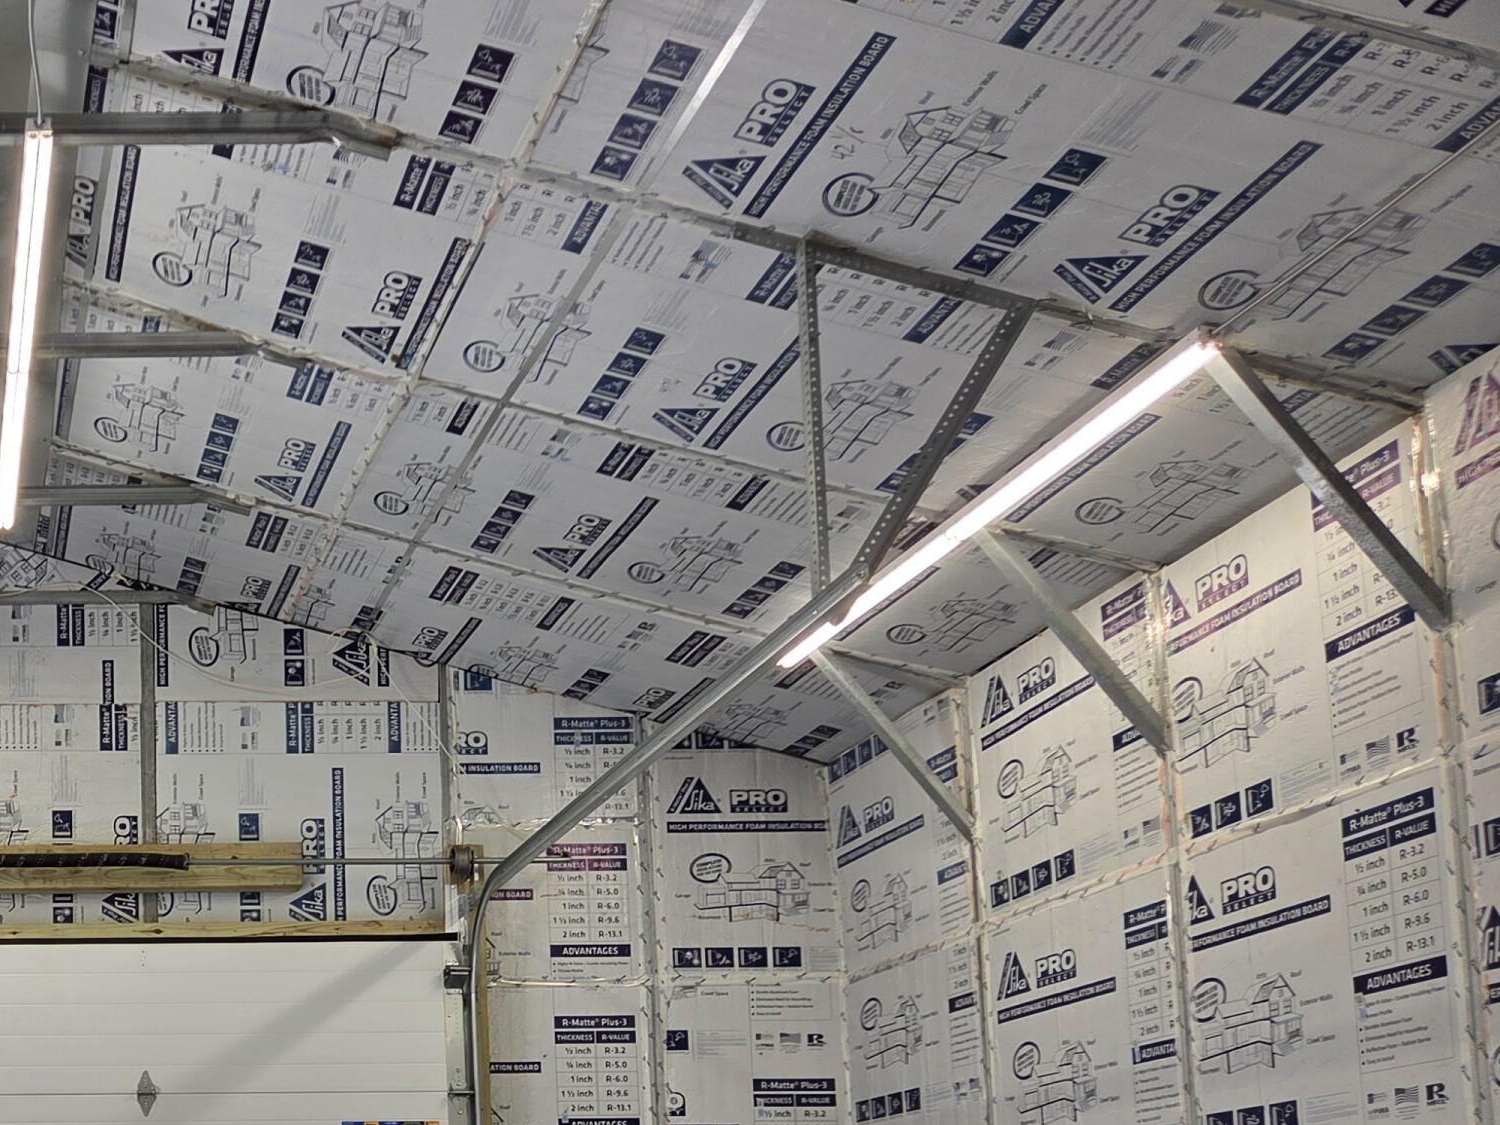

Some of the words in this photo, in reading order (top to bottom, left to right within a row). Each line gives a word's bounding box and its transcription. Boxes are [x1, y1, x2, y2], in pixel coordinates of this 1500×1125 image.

[860, 36, 889, 72] BOARD
[734, 79, 801, 142] PRO
[768, 90, 810, 143] SELECT
[1120, 185, 1202, 244] PRO
[1082, 258, 1135, 288] Sika
[371, 270, 410, 317] PRO
[693, 356, 745, 401] PRO
[563, 514, 602, 545] PRO
[1195, 554, 1247, 598] PRO
[1338, 615, 1401, 652] ADVANTAGES
[158, 666, 167, 686] HIGH
[1018, 656, 1057, 692] PRO
[600, 718, 626, 729] Plus-3
[467, 764, 511, 772] INSULATION
[513, 764, 539, 772] BOARD
[333, 769, 343, 795] BOARD
[685, 790, 715, 811] Sika
[730, 790, 788, 806] PRO
[1393, 796, 1424, 816] Plus-3
[669, 823, 687, 831] HIGH
[689, 823, 742, 831] PERFORMANCE
[1344, 836, 1386, 857] THICKNESS
[1394, 820, 1429, 839] R-VALUE
[1399, 843, 1425, 861] R-3.2
[1221, 866, 1276, 901] PRO
[1401, 866, 1428, 884] R-5.0
[1226, 892, 1274, 914] SELECT
[1403, 889, 1429, 906] R-6.0
[562, 946, 619, 955] ADVANTAGES
[1406, 936, 1435, 952] R-13.1
[1035, 949, 1076, 979] PRO
[1366, 964, 1432, 989] ADVANTAGES
[602, 1017, 628, 1027] Plus-3
[557, 1033, 593, 1042] THICKNESS
[601, 1033, 630, 1041] R-VALUE
[605, 1075, 629, 1083] R-6.0
[801, 1081, 828, 1090] Plus-3
[606, 1089, 629, 1097] R-9.6
[607, 1104, 632, 1112] R-13.1
[804, 1110, 826, 1118] R-3.2
